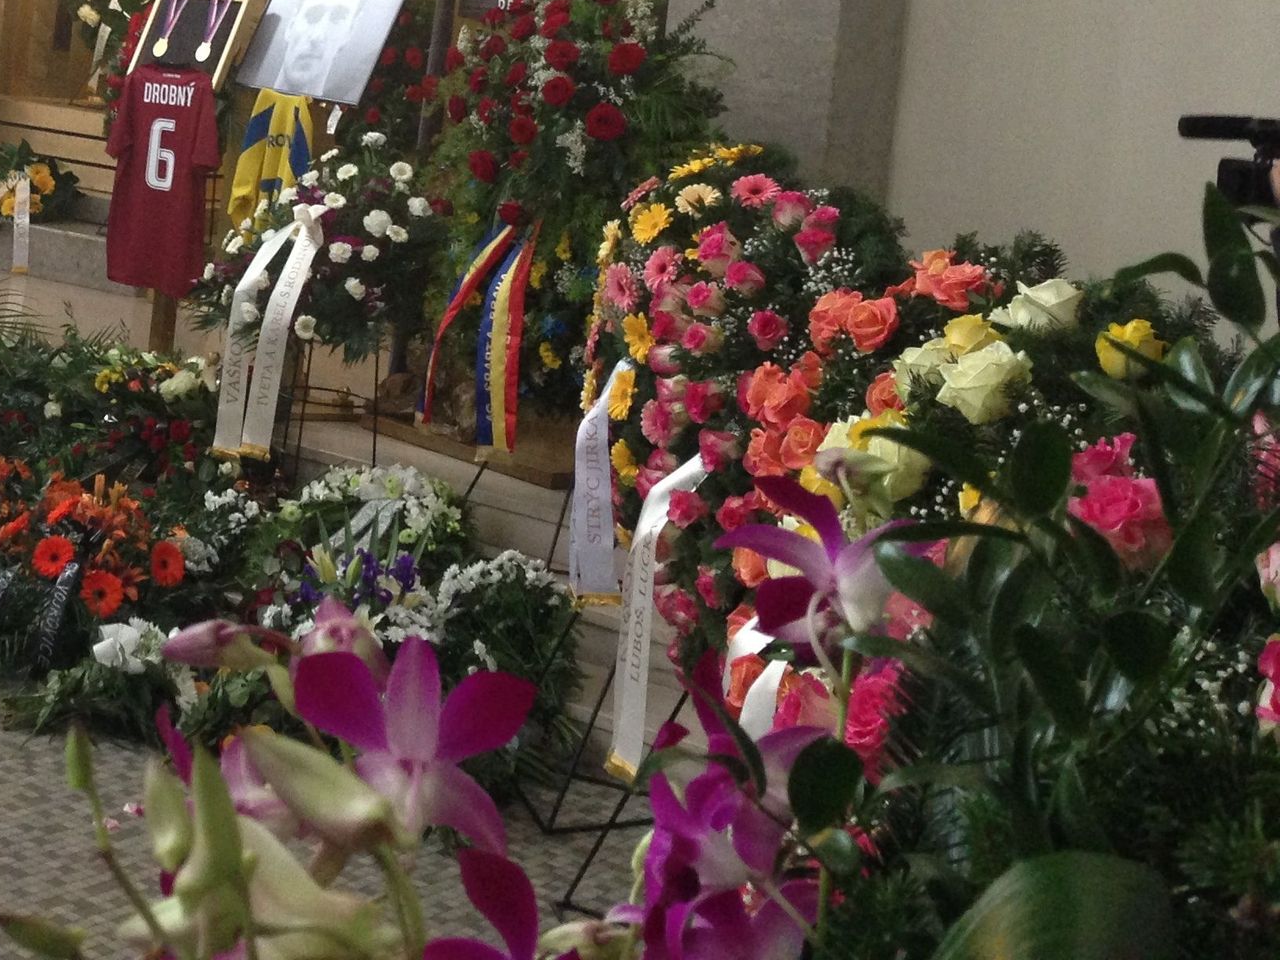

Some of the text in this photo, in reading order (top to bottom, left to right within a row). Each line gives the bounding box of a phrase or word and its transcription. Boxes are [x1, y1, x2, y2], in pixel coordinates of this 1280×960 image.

[143, 81, 196, 107] DROBNÝ
[146, 118, 176, 191] 6
[284, 237, 313, 289] RODINO
